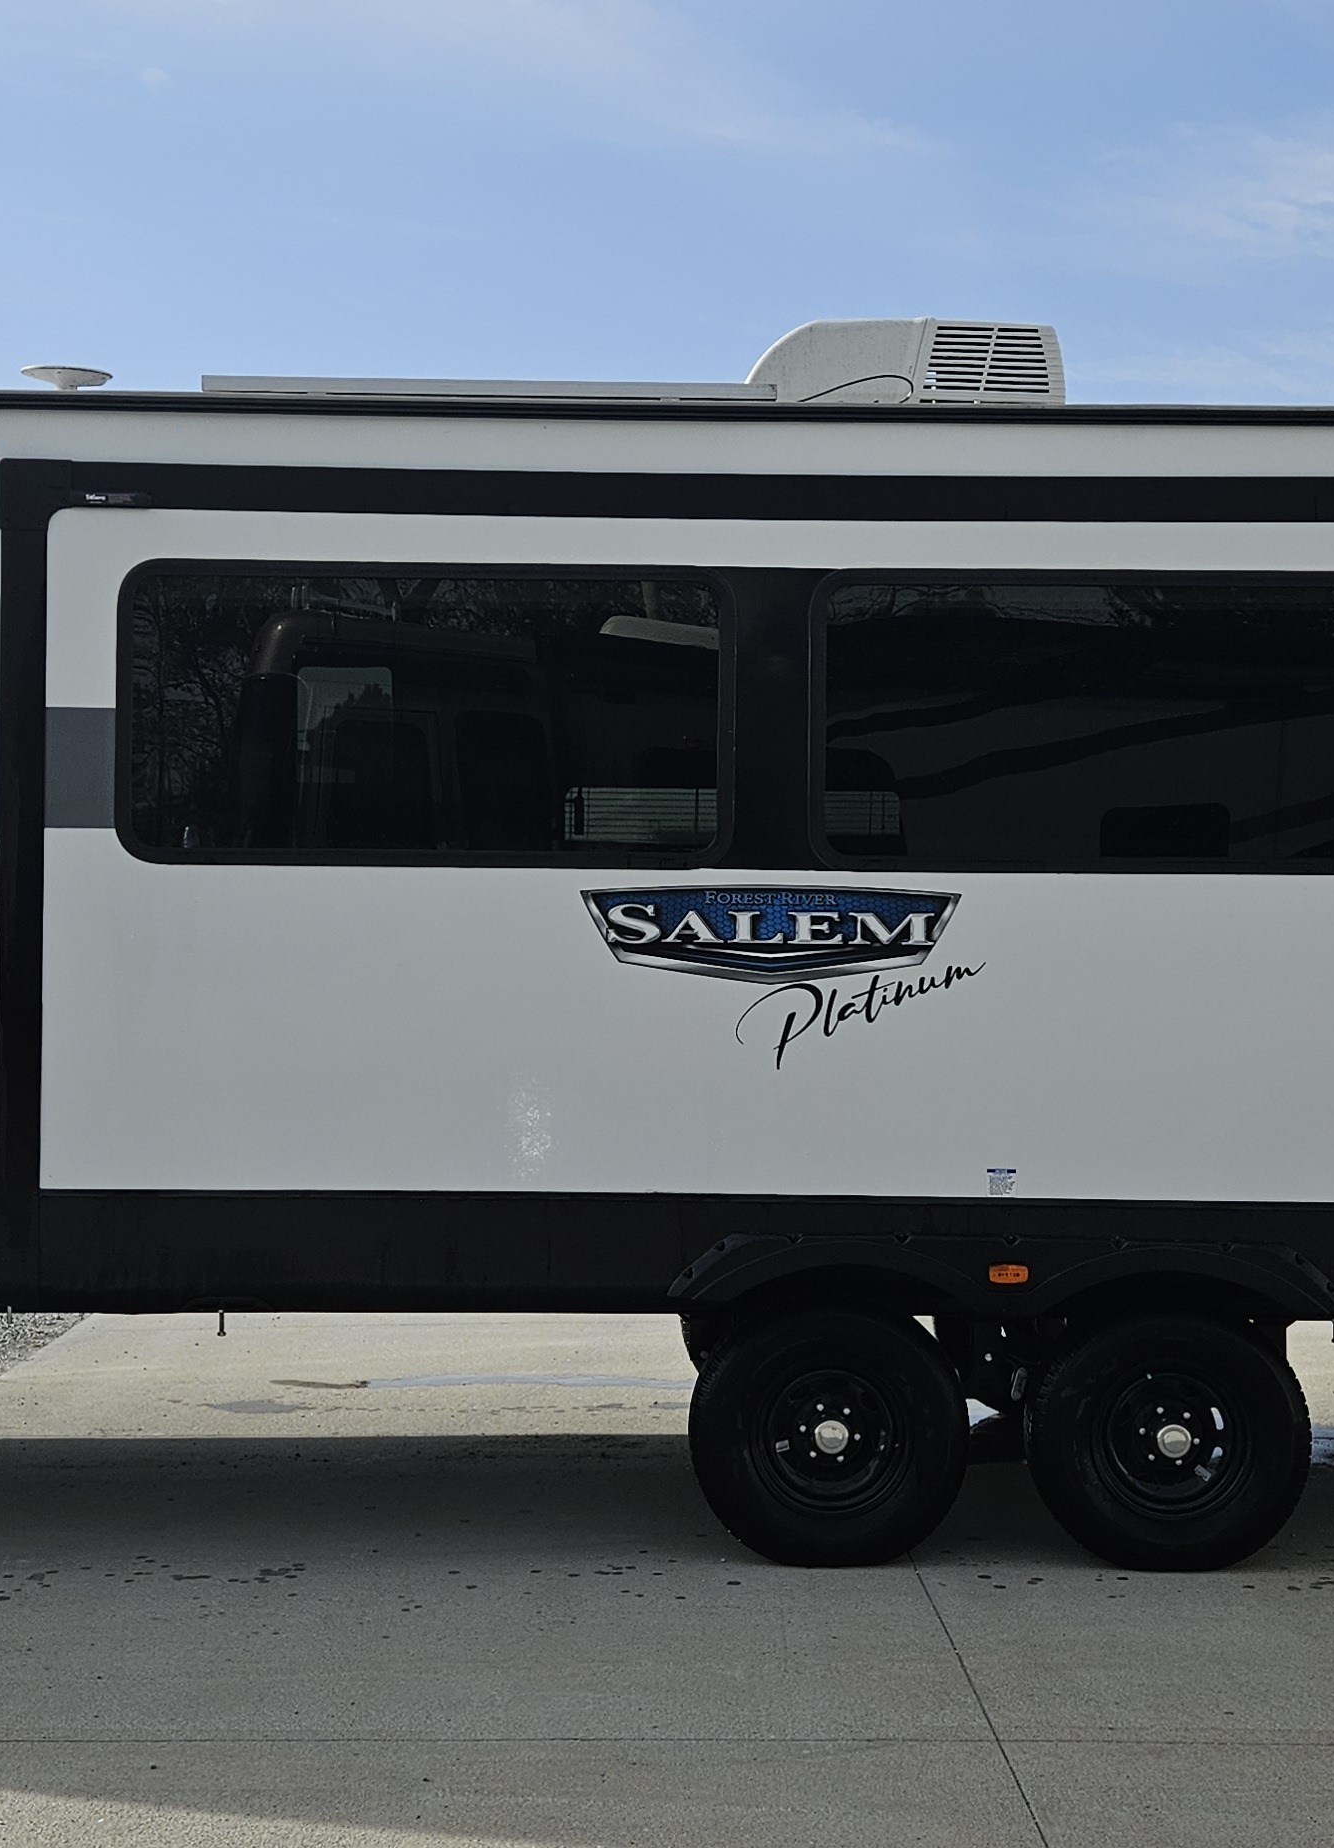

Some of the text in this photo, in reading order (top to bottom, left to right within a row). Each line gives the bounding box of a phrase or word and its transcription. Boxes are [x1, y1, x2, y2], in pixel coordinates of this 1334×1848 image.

[704, 890, 837, 906] FOREST RIVER
[606, 903, 937, 946] SALEM
[735, 961, 986, 1070] Platinum
